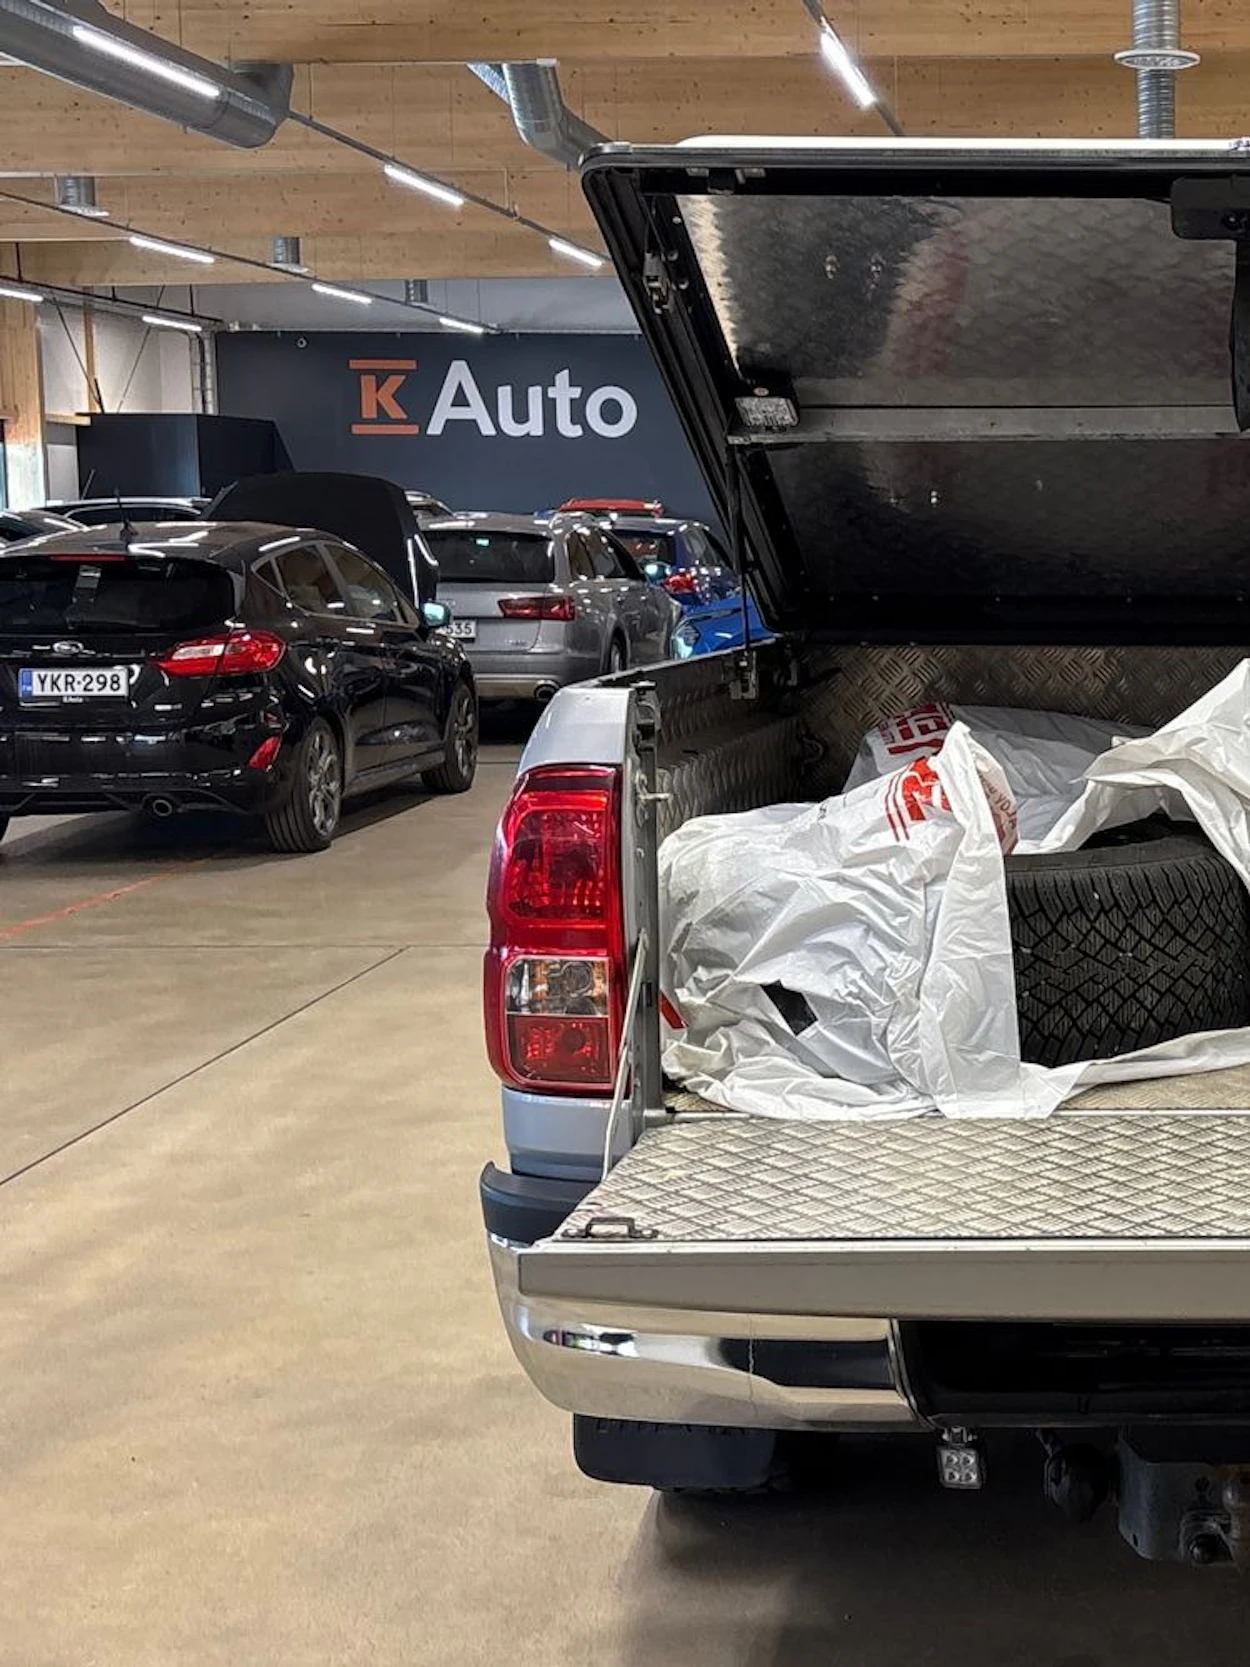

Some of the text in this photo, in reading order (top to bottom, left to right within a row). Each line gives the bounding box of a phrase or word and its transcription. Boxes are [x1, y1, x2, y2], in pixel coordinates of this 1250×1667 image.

[360, 359, 638, 438] K Auto
[37, 673, 121, 692] YKR-298
